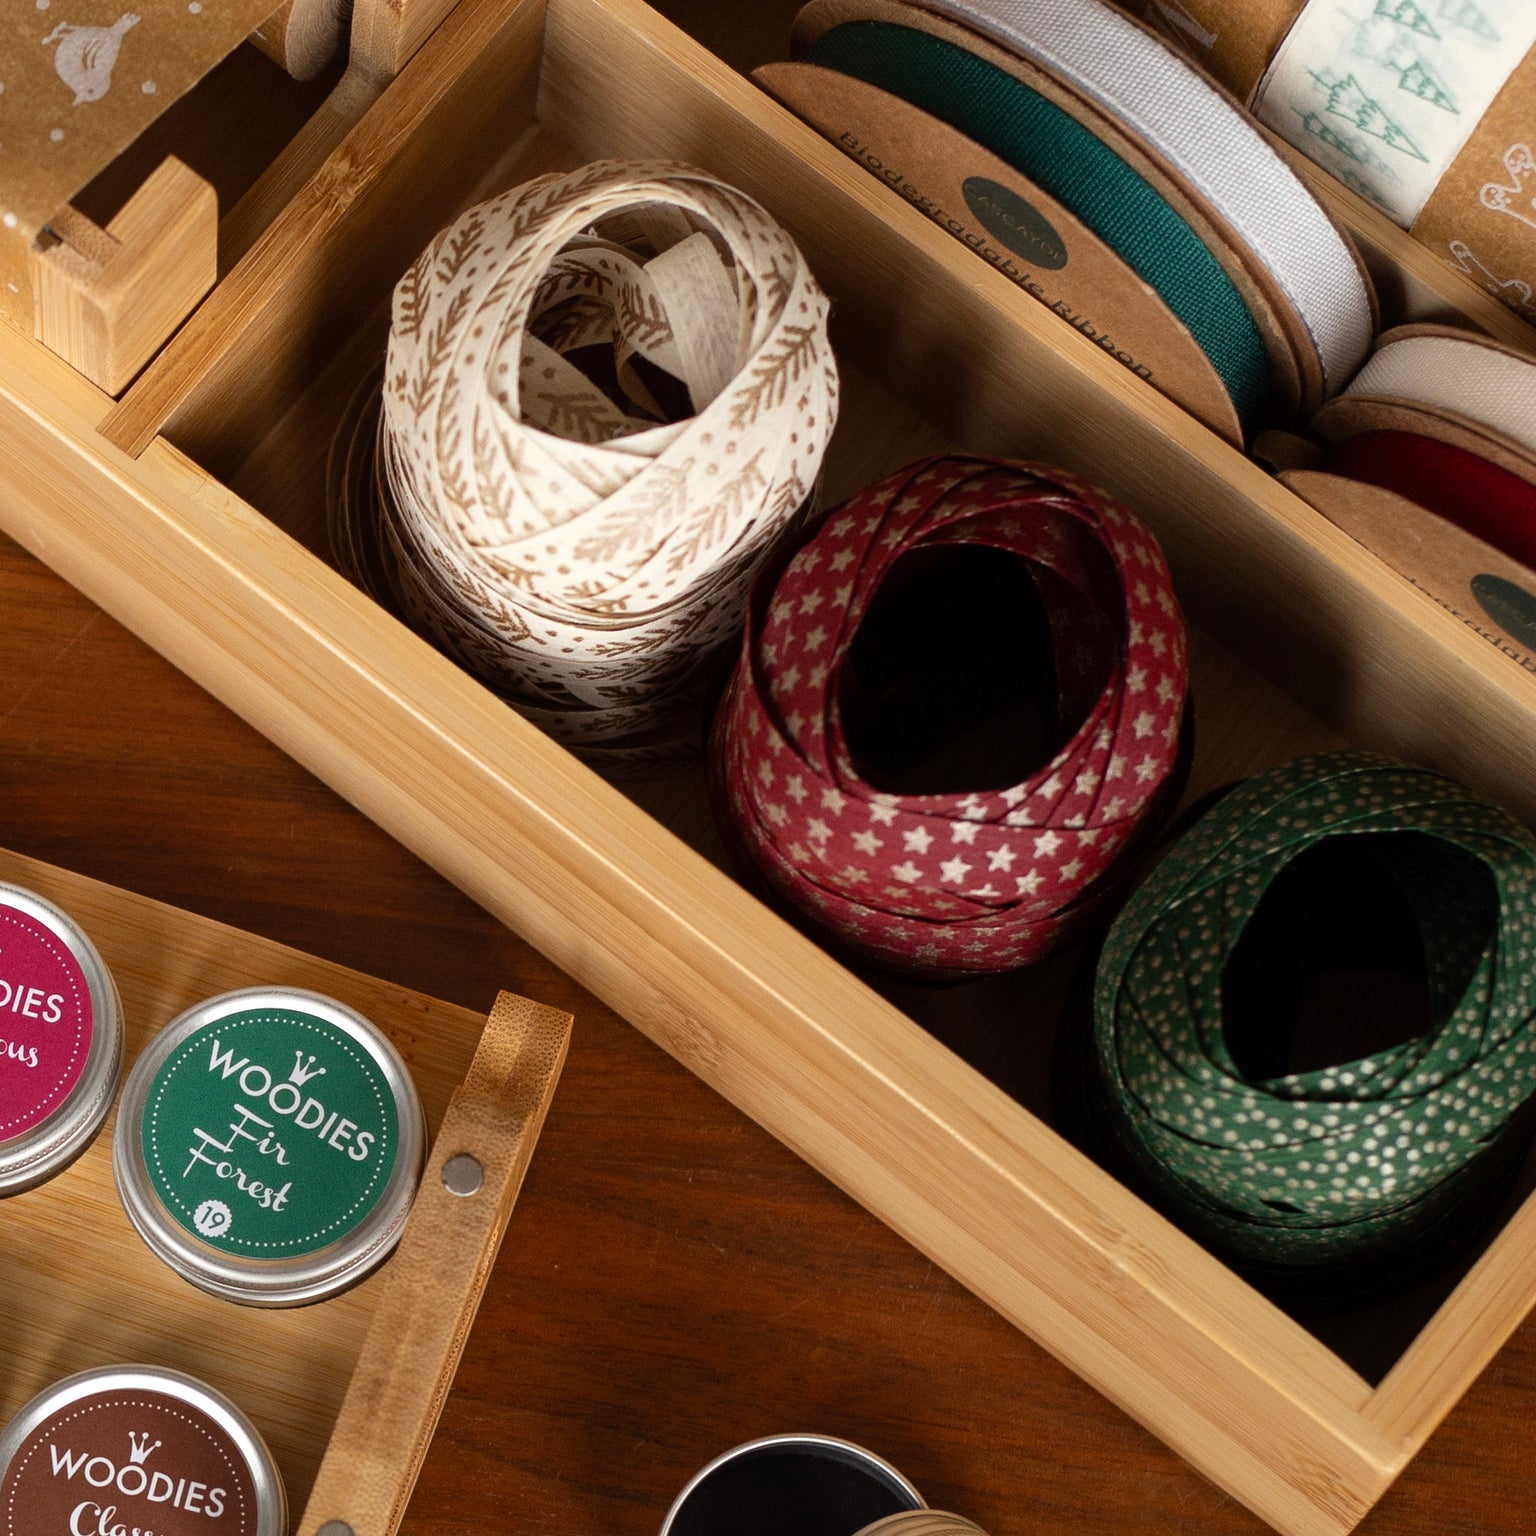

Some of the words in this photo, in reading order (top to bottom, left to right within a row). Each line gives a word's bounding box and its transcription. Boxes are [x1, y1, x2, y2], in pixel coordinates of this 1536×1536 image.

[839, 131, 1045, 297] Biodegradable
[1051, 299, 1156, 380] Ribbon
[208, 1039, 375, 1161] WOODIES
[225, 1103, 290, 1166] Fir
[182, 1127, 292, 1212] Forest
[199, 1205, 226, 1231] 19
[50, 1443, 227, 1518] WOODIES
